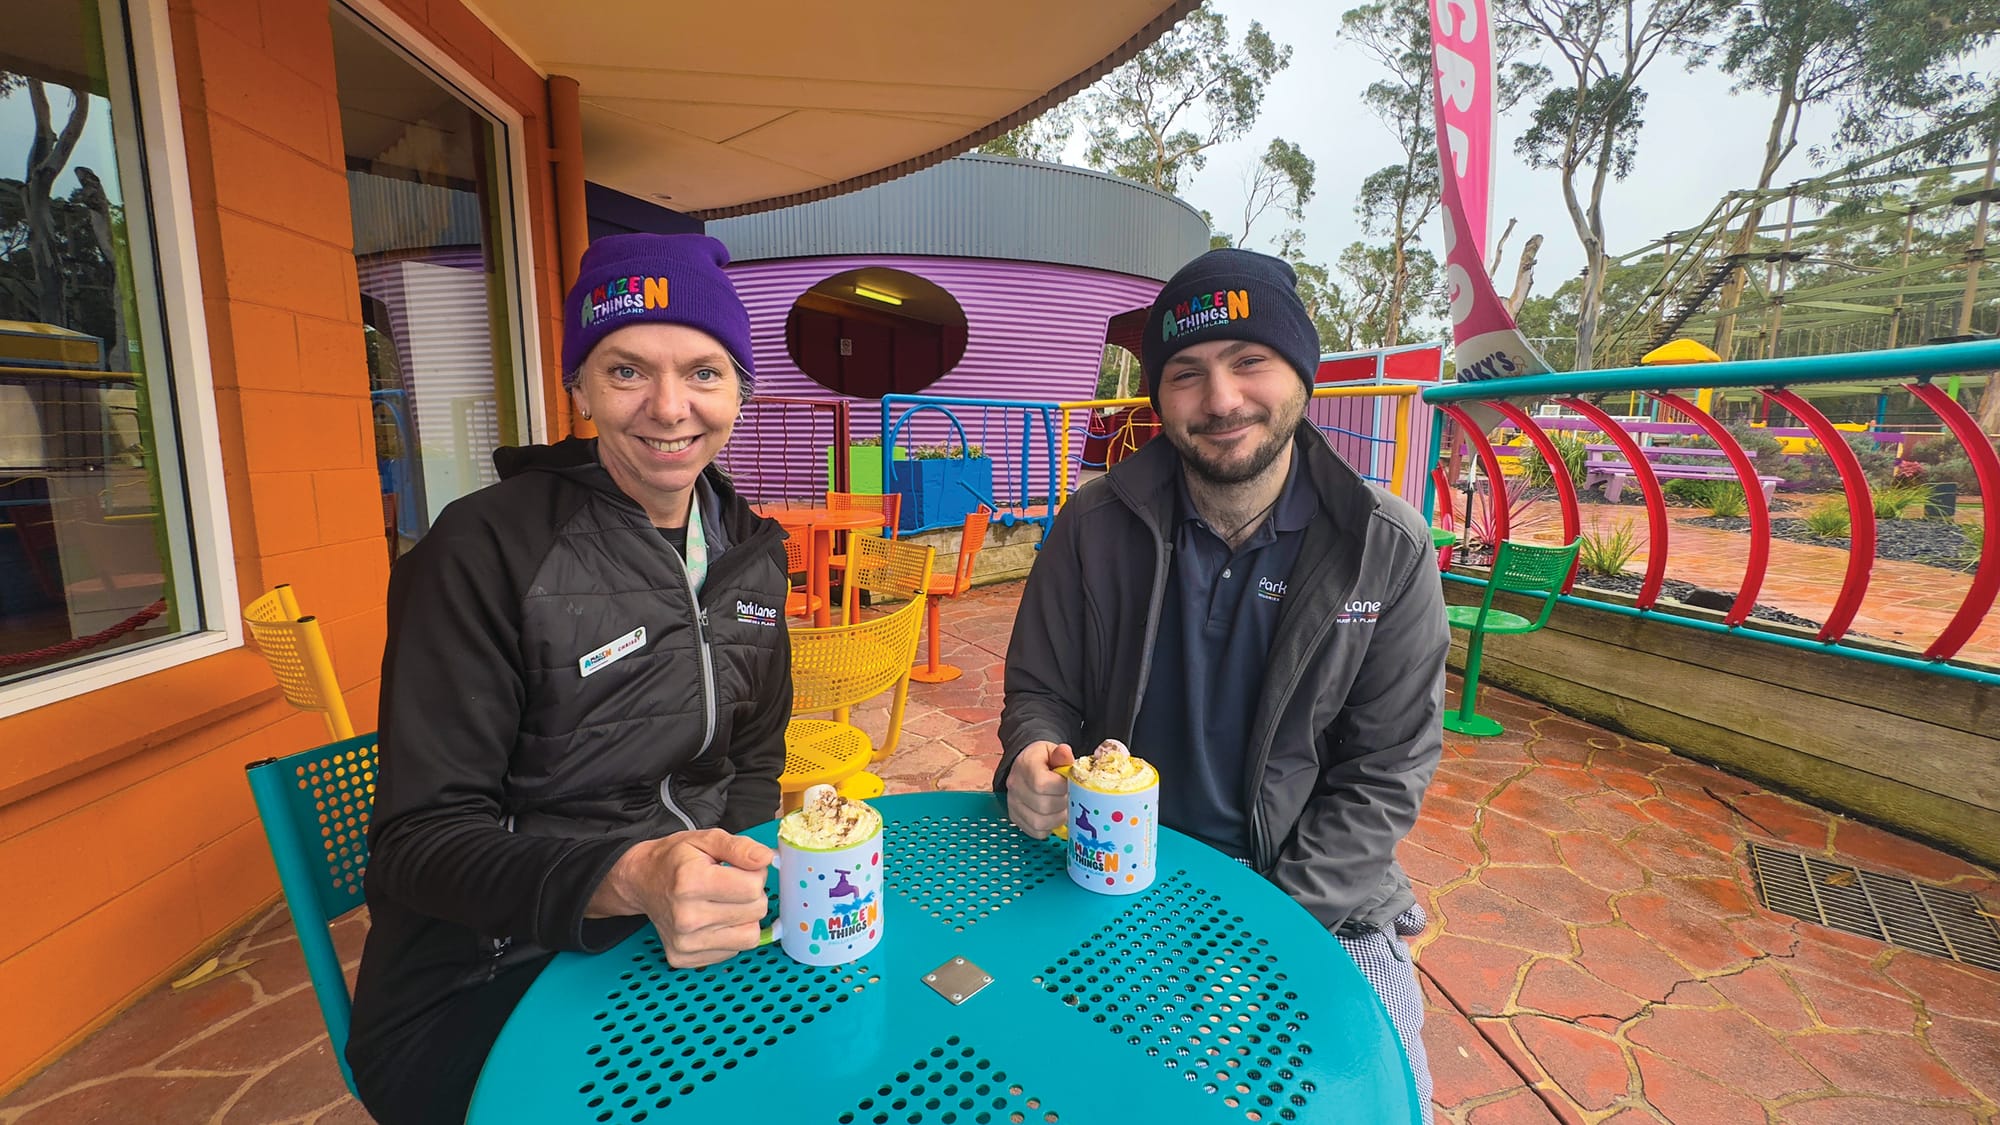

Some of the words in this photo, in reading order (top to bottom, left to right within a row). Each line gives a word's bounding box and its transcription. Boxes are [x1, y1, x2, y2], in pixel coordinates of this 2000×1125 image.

[592, 293, 644, 319] THINGS
[1176, 306, 1229, 332] THINGS
[1258, 576, 1288, 595] Park
[736, 600, 754, 615] Park
[754, 603, 777, 618] Lane
[1344, 600, 1381, 613] Lane
[1075, 853, 1104, 872] THINGS
[828, 920, 867, 940] THINGS
